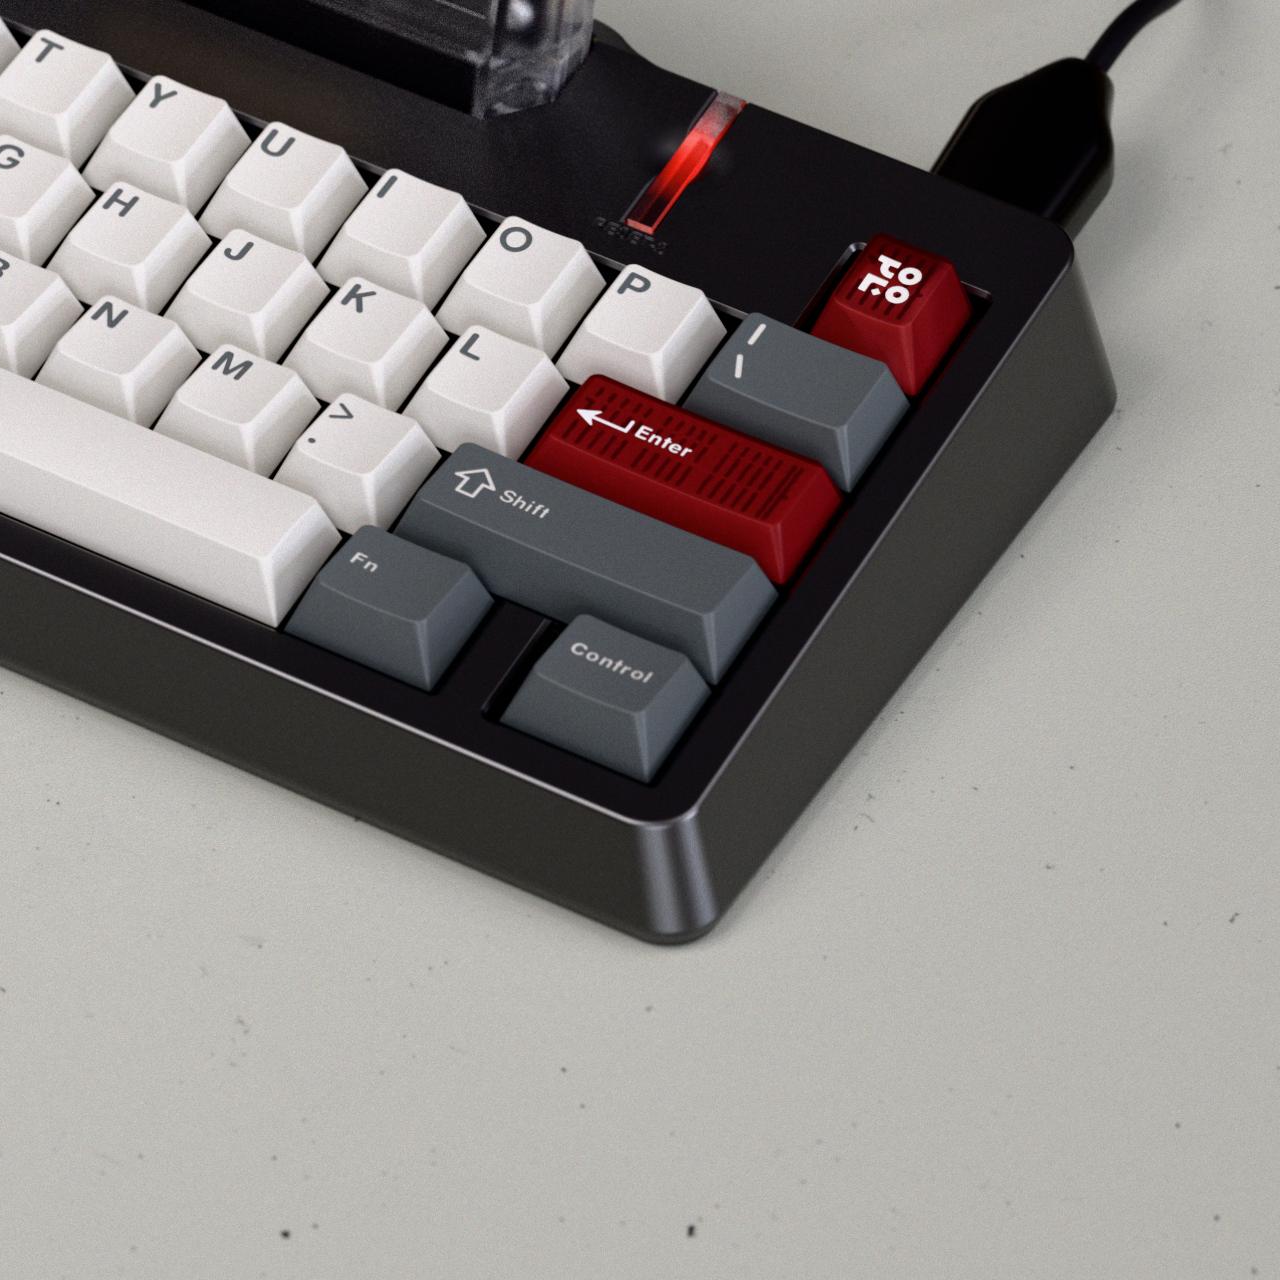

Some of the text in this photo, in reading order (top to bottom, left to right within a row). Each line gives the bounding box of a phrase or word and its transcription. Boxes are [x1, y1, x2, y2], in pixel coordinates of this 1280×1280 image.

[35, 37, 64, 63] T
[149, 82, 178, 109] Y
[260, 129, 296, 157] U
[377, 175, 398, 198] I
[102, 188, 139, 217] H
[223, 241, 254, 261] J
[499, 226, 533, 253] O
[617, 272, 651, 295] P
[340, 283, 376, 313] K
[91, 301, 129, 329] N
[459, 333, 480, 361] L
[211, 351, 254, 381] M
[631, 421, 693, 457] Enter
[499, 489, 550, 519] Shift
[349, 551, 378, 572] Fn
[570, 642, 653, 683] Control
